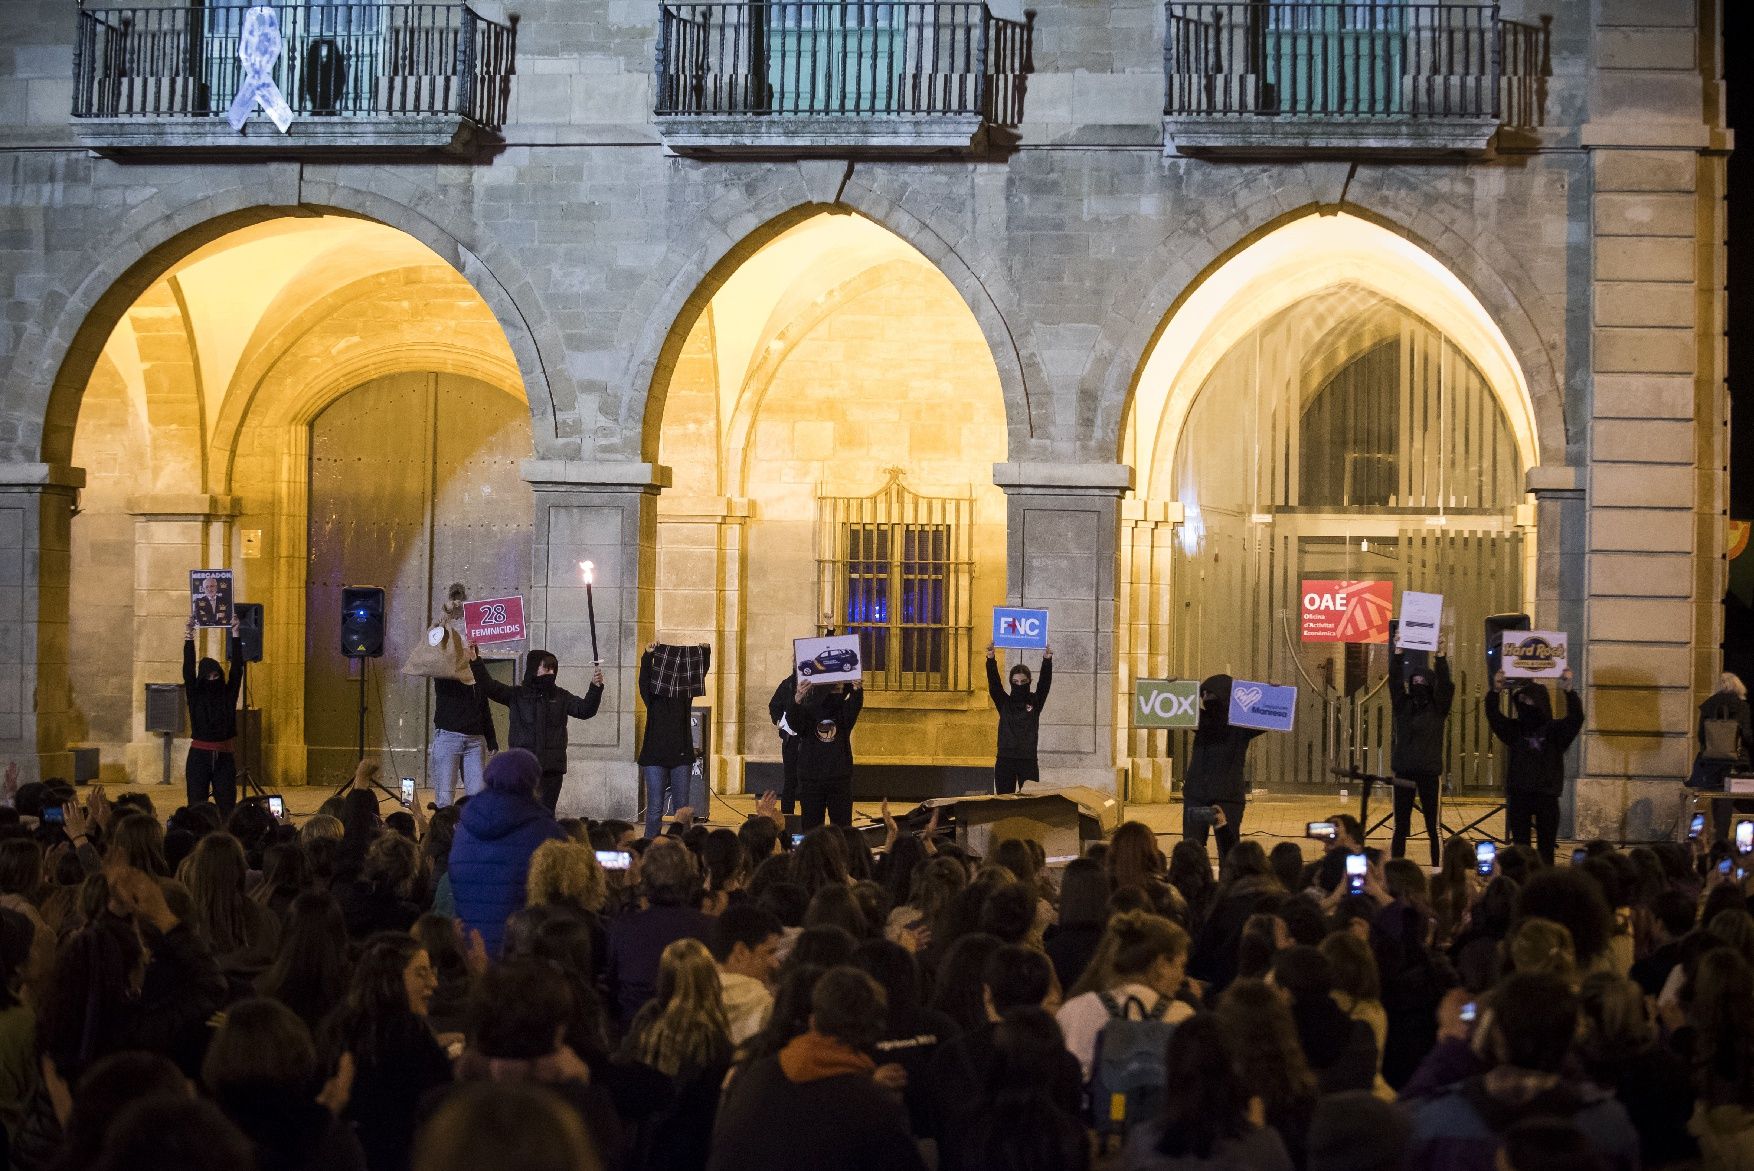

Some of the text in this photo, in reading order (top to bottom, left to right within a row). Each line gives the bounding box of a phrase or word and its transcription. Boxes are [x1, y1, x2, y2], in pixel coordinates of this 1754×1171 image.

[1303, 593, 1347, 610] OAE
[480, 604, 507, 625] 28
[471, 624, 520, 638] FEMINICIDIS
[1503, 643, 1565, 659] Hard Rock
[1139, 689, 1196, 718] VOX
